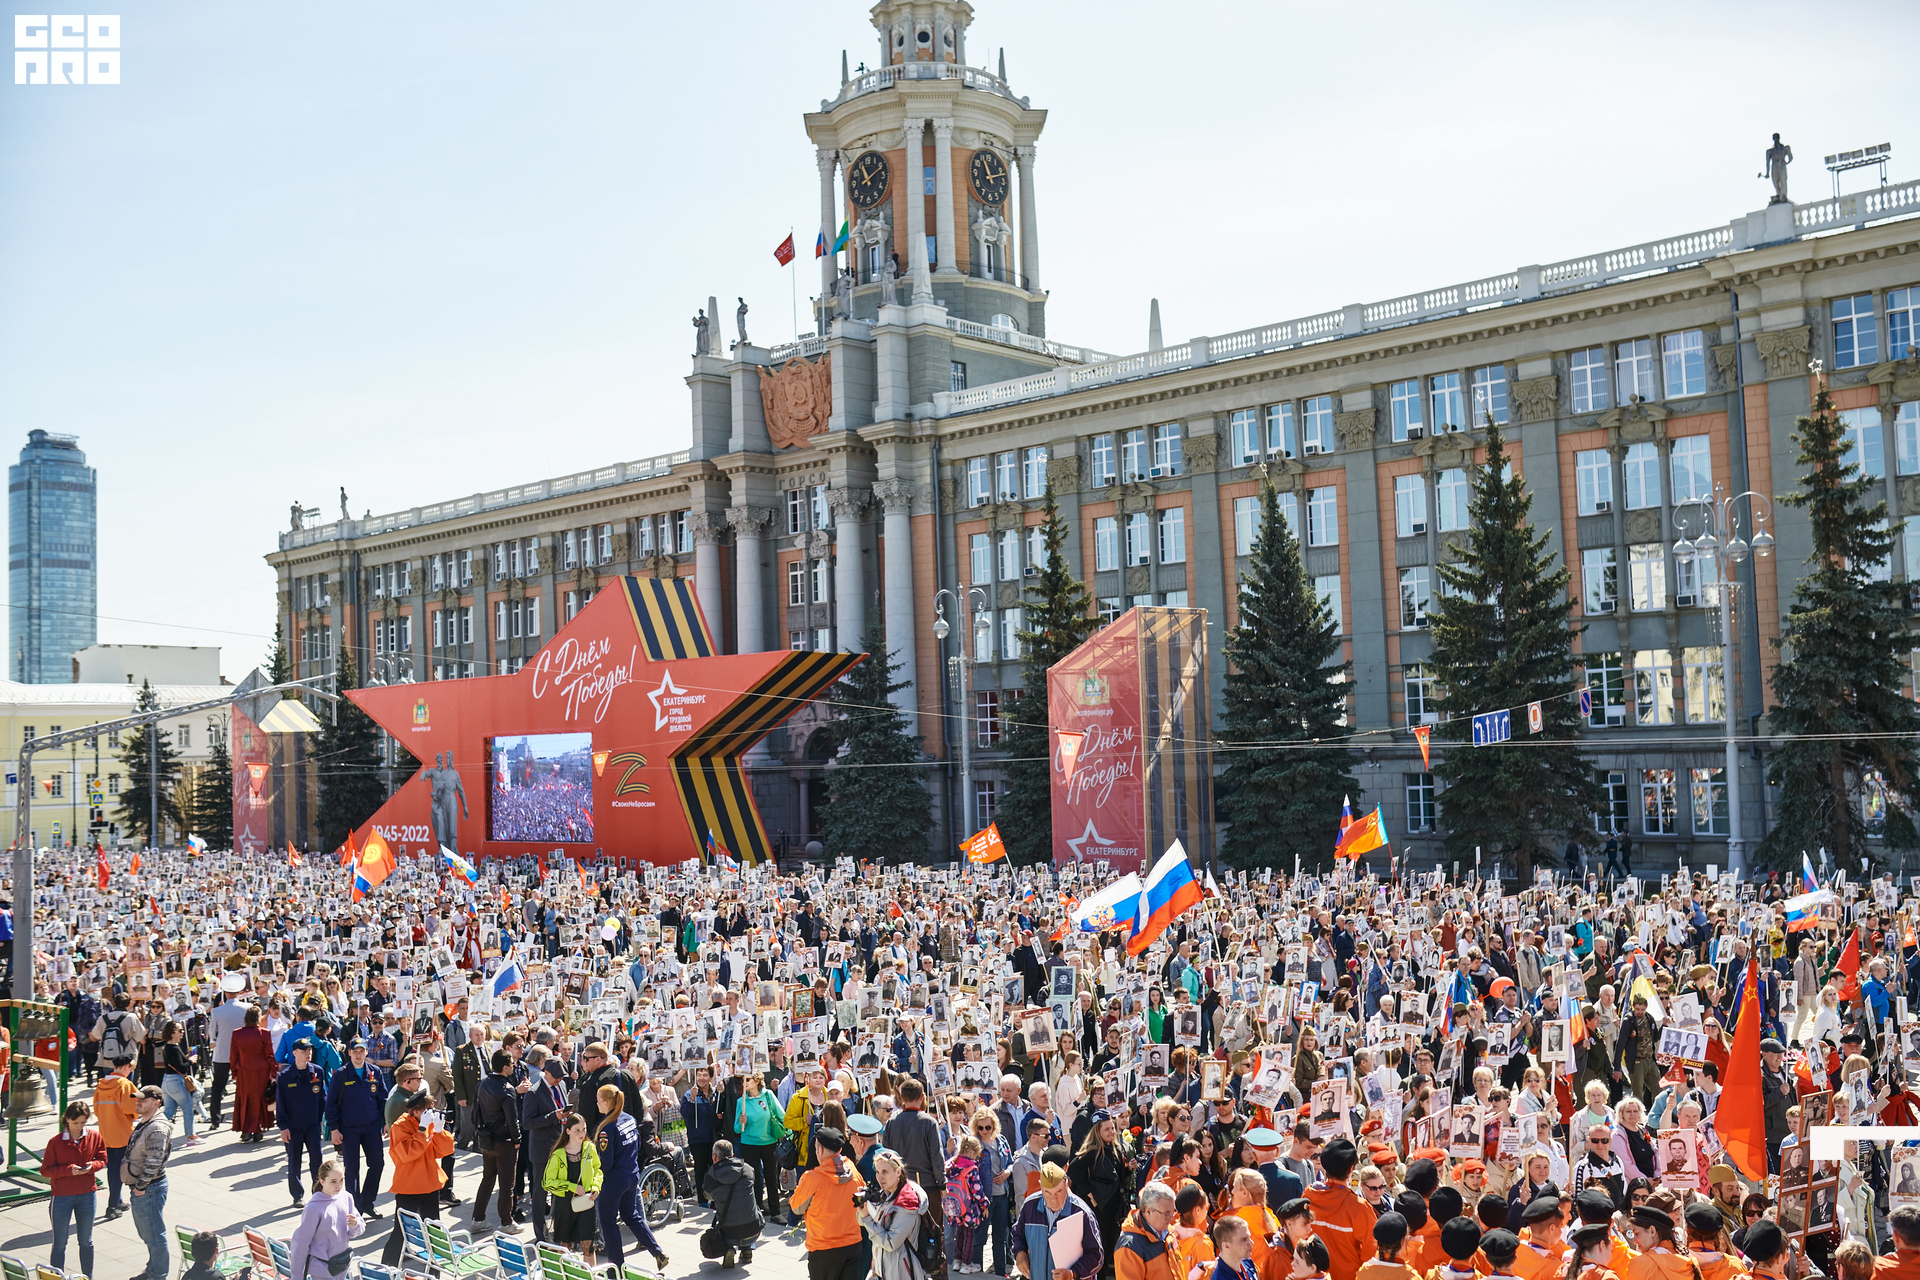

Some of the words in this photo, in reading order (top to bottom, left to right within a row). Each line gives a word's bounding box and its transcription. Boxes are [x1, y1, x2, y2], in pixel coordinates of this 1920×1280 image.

[532, 650, 550, 699] С
[554, 637, 611, 685] Днём
[560, 645, 636, 724] Победы!
[663, 695, 706, 706] ЕКАТЕРИНБУРГ
[669, 714, 692, 724] ТРУДОВОЙ
[669, 725, 692, 733] ДОБЛЕСТИ
[1077, 724, 1134, 762] Днём
[610, 752, 651, 797] Z
[1062, 746, 1137, 808] Победы!
[1086, 846, 1138, 856] ЕКАТЕРИНБУРГ
